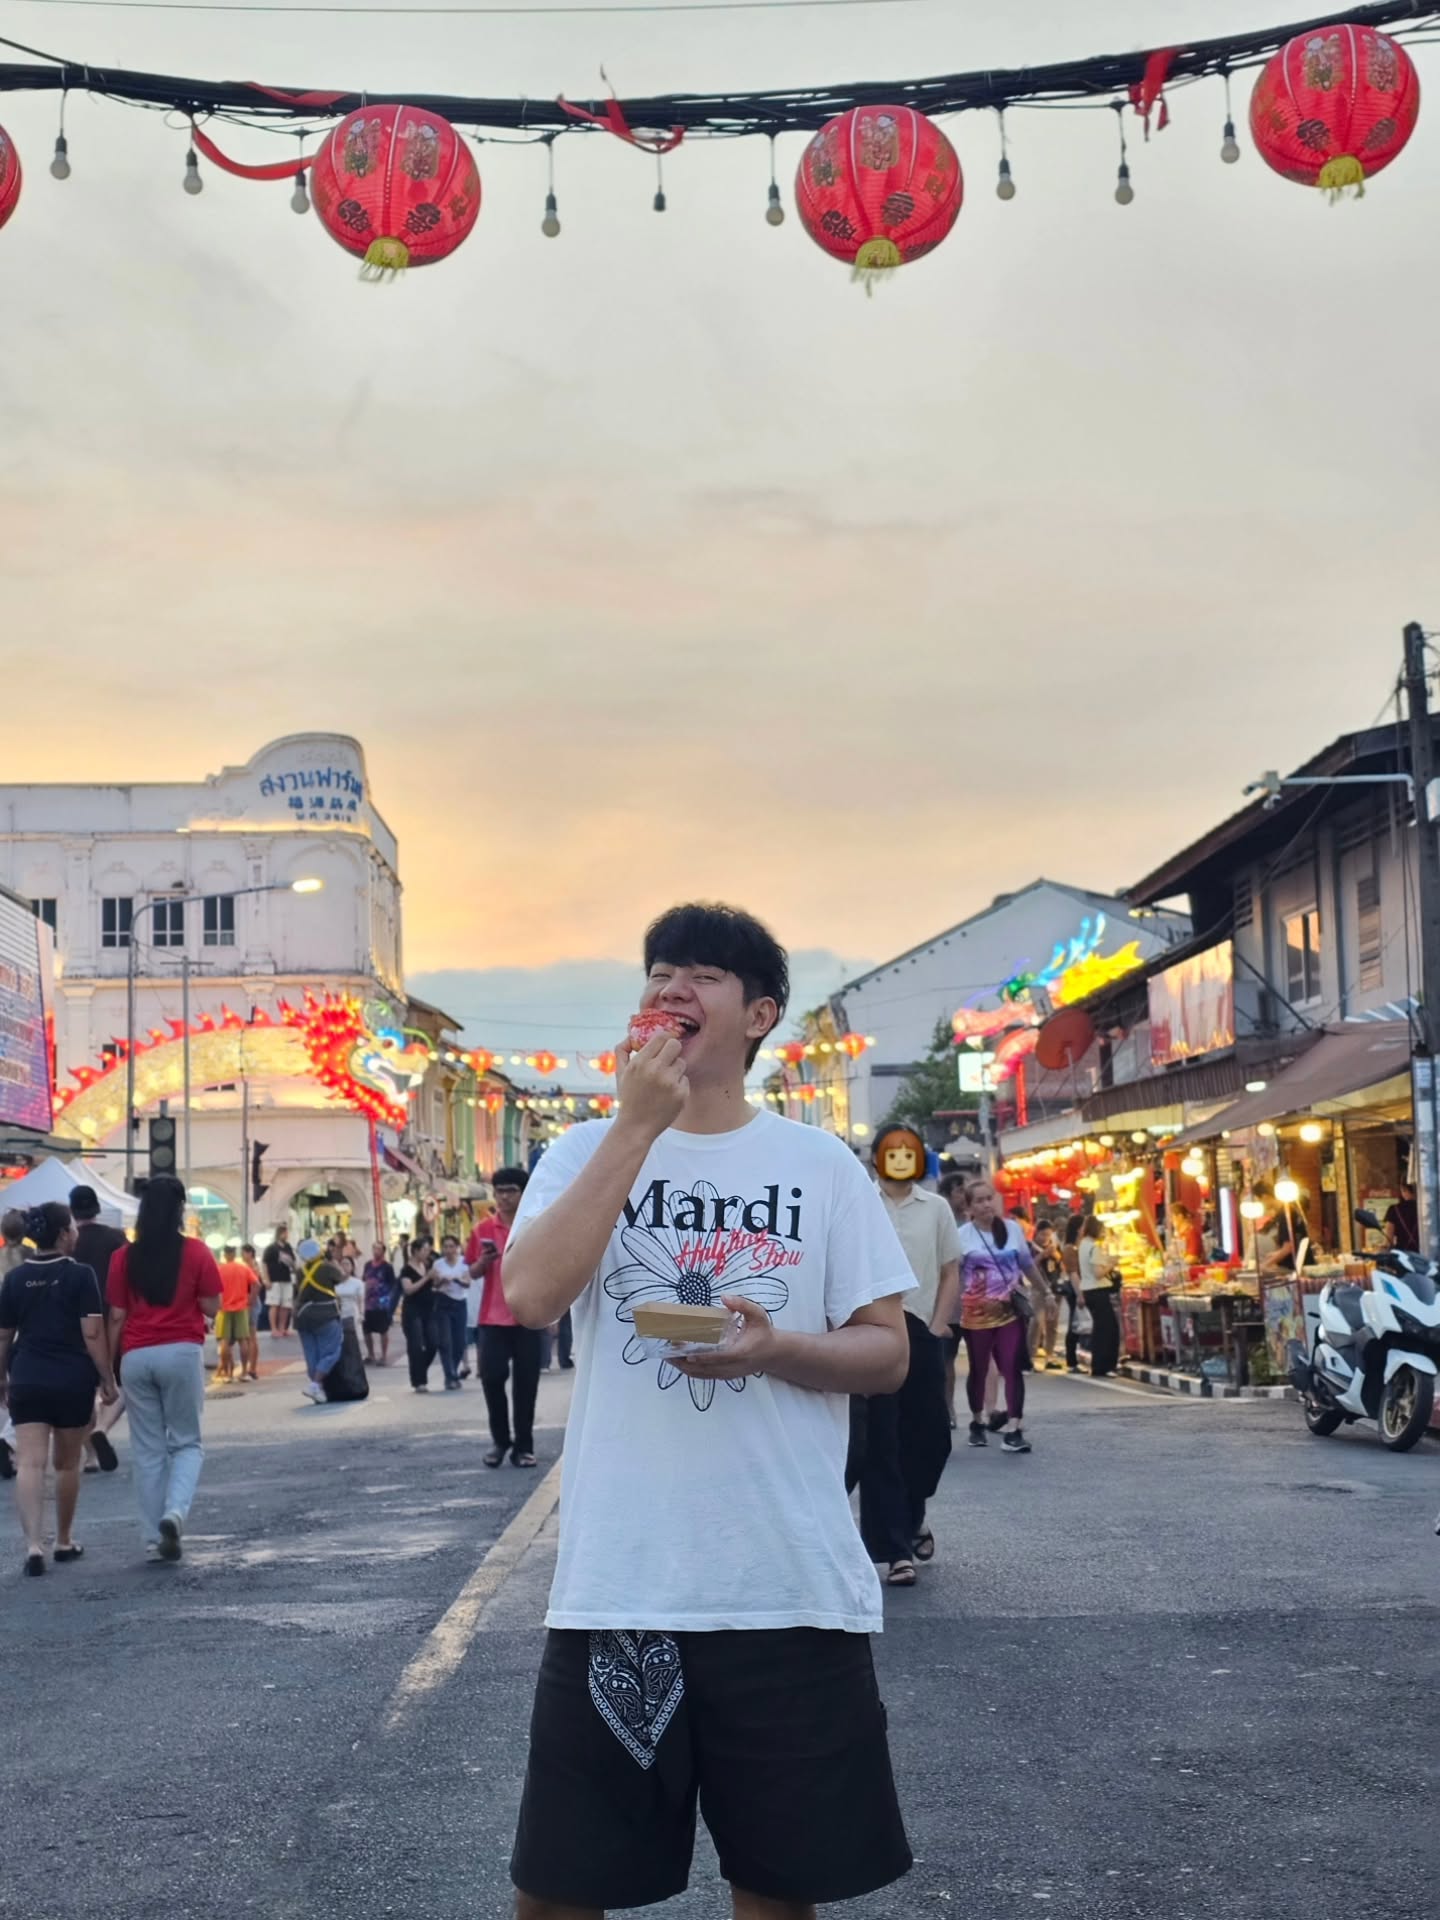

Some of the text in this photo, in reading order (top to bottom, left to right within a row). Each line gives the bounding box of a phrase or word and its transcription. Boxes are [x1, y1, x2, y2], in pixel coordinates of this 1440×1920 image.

[614, 1179, 802, 1242] Mardi
[674, 1226, 727, 1277] Half
[749, 1242, 805, 1271] Show
